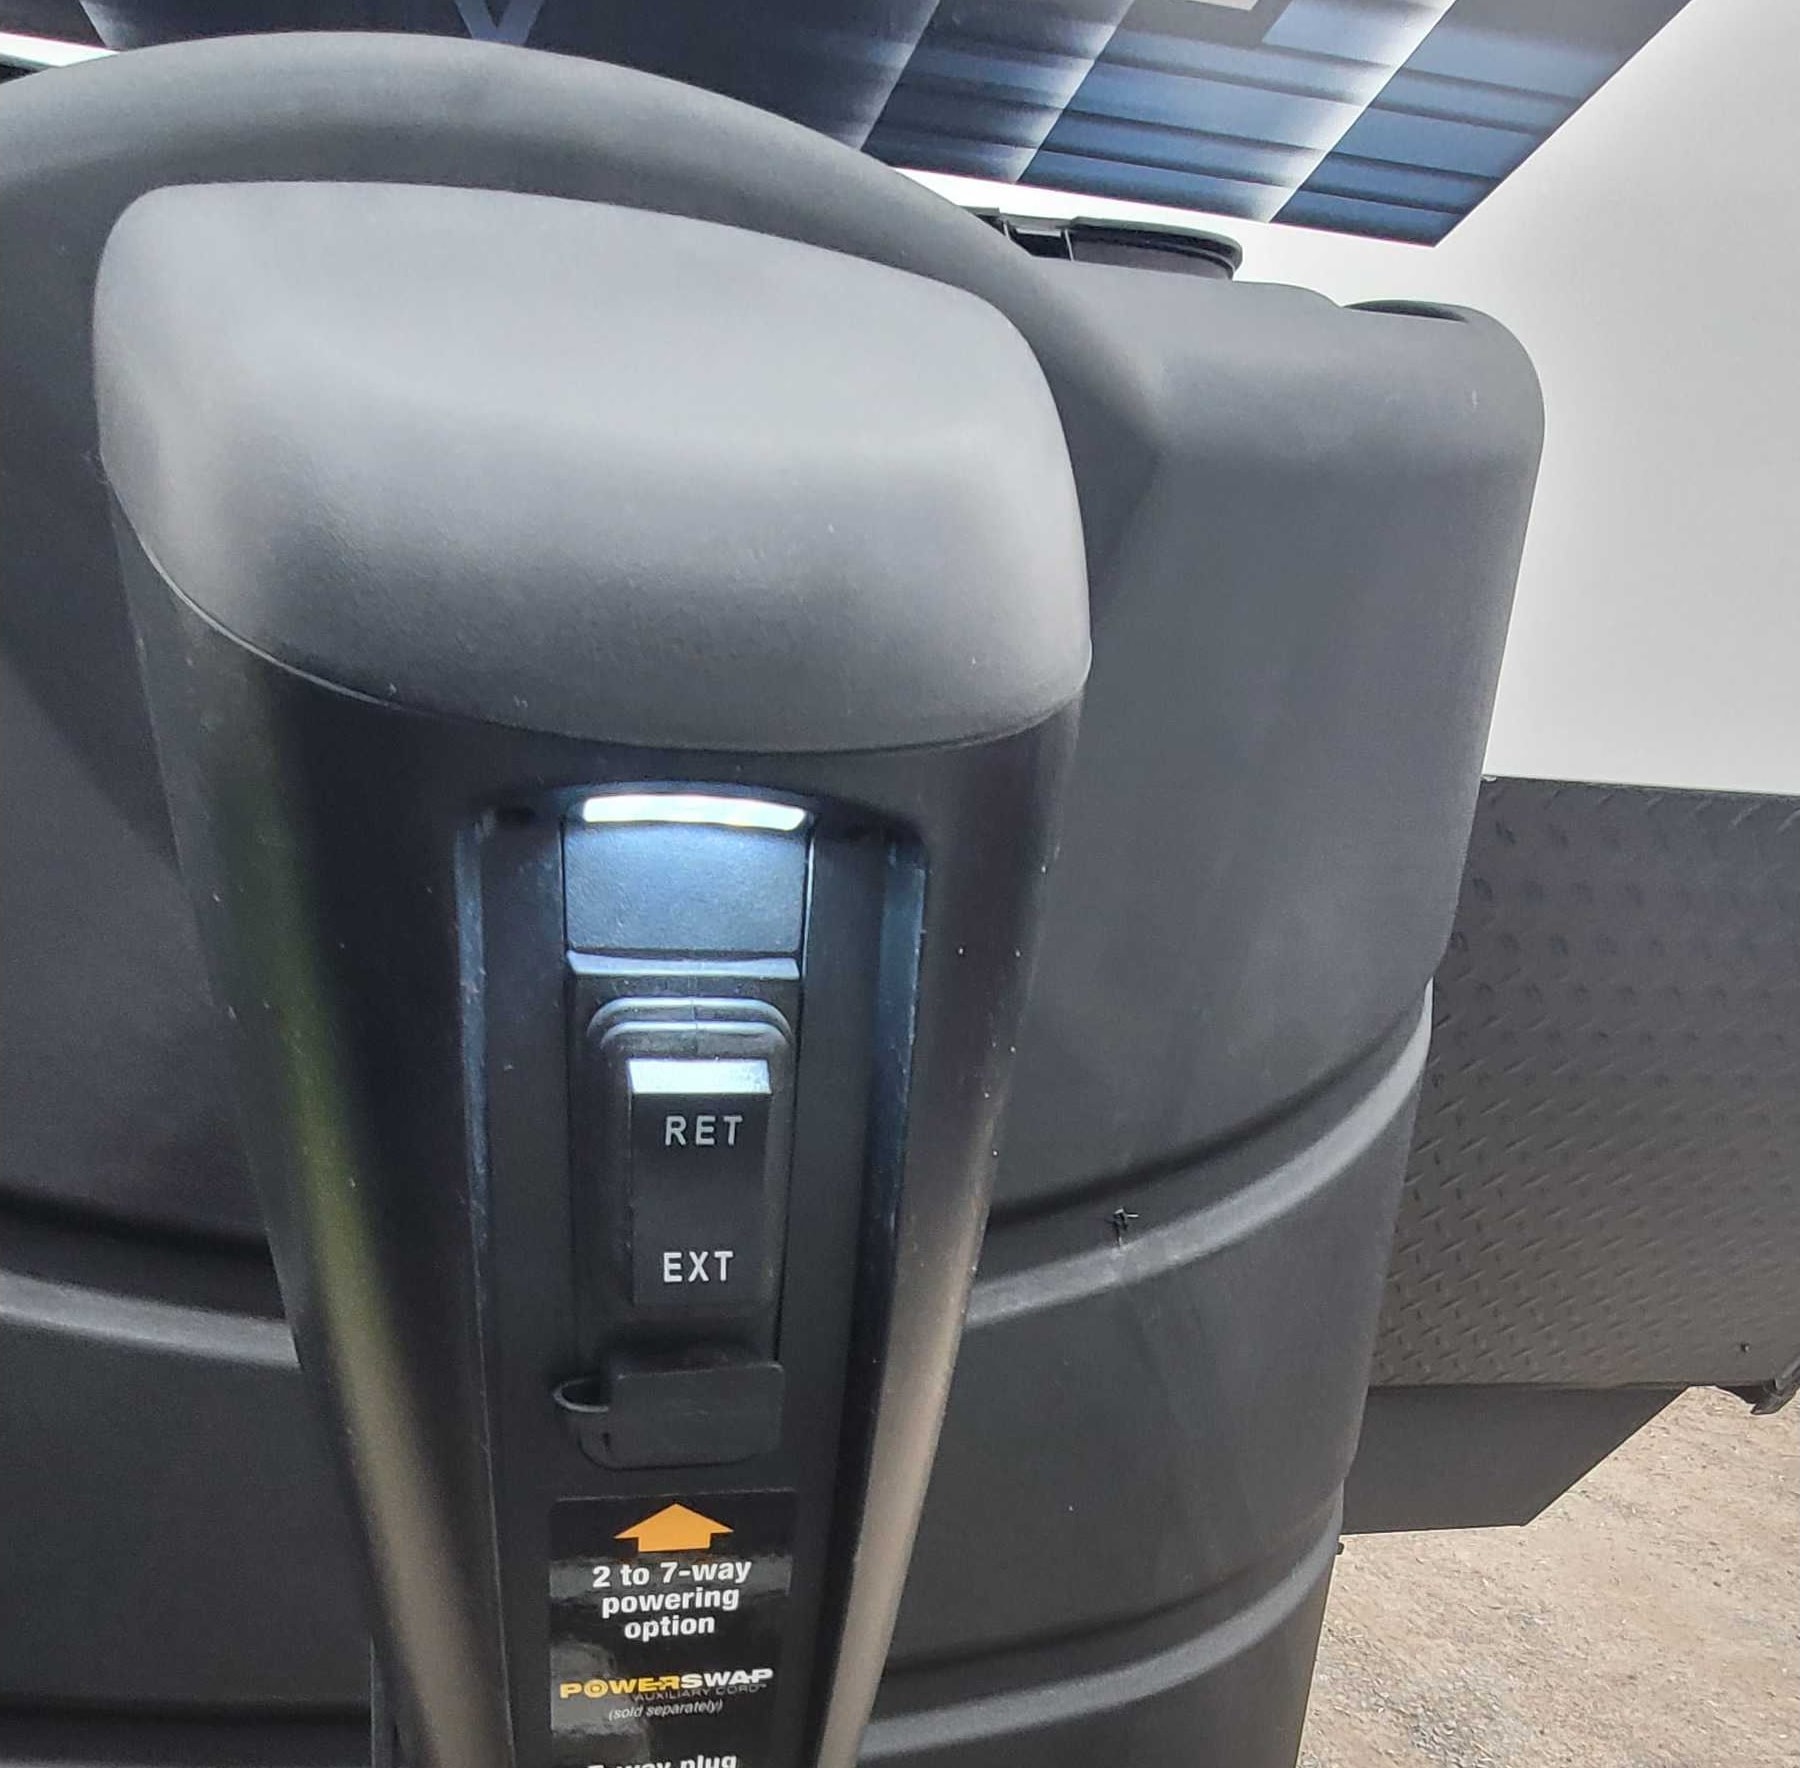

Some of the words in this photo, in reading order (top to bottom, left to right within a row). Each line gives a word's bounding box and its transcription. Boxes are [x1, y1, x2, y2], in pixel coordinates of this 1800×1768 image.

[664, 1115, 744, 1146] RET
[662, 1251, 734, 1284] EXT
[592, 1566, 611, 1588] 2
[620, 1565, 649, 1586] to
[660, 1560, 753, 1584] 7-way
[601, 1587, 740, 1619] powering
[624, 1615, 715, 1642] option
[559, 1668, 774, 1699] POWERSWAP
[633, 1687, 711, 1702] AUXILIARY
[608, 1705, 644, 1722] (sold
[646, 1699, 724, 1718] separately)
